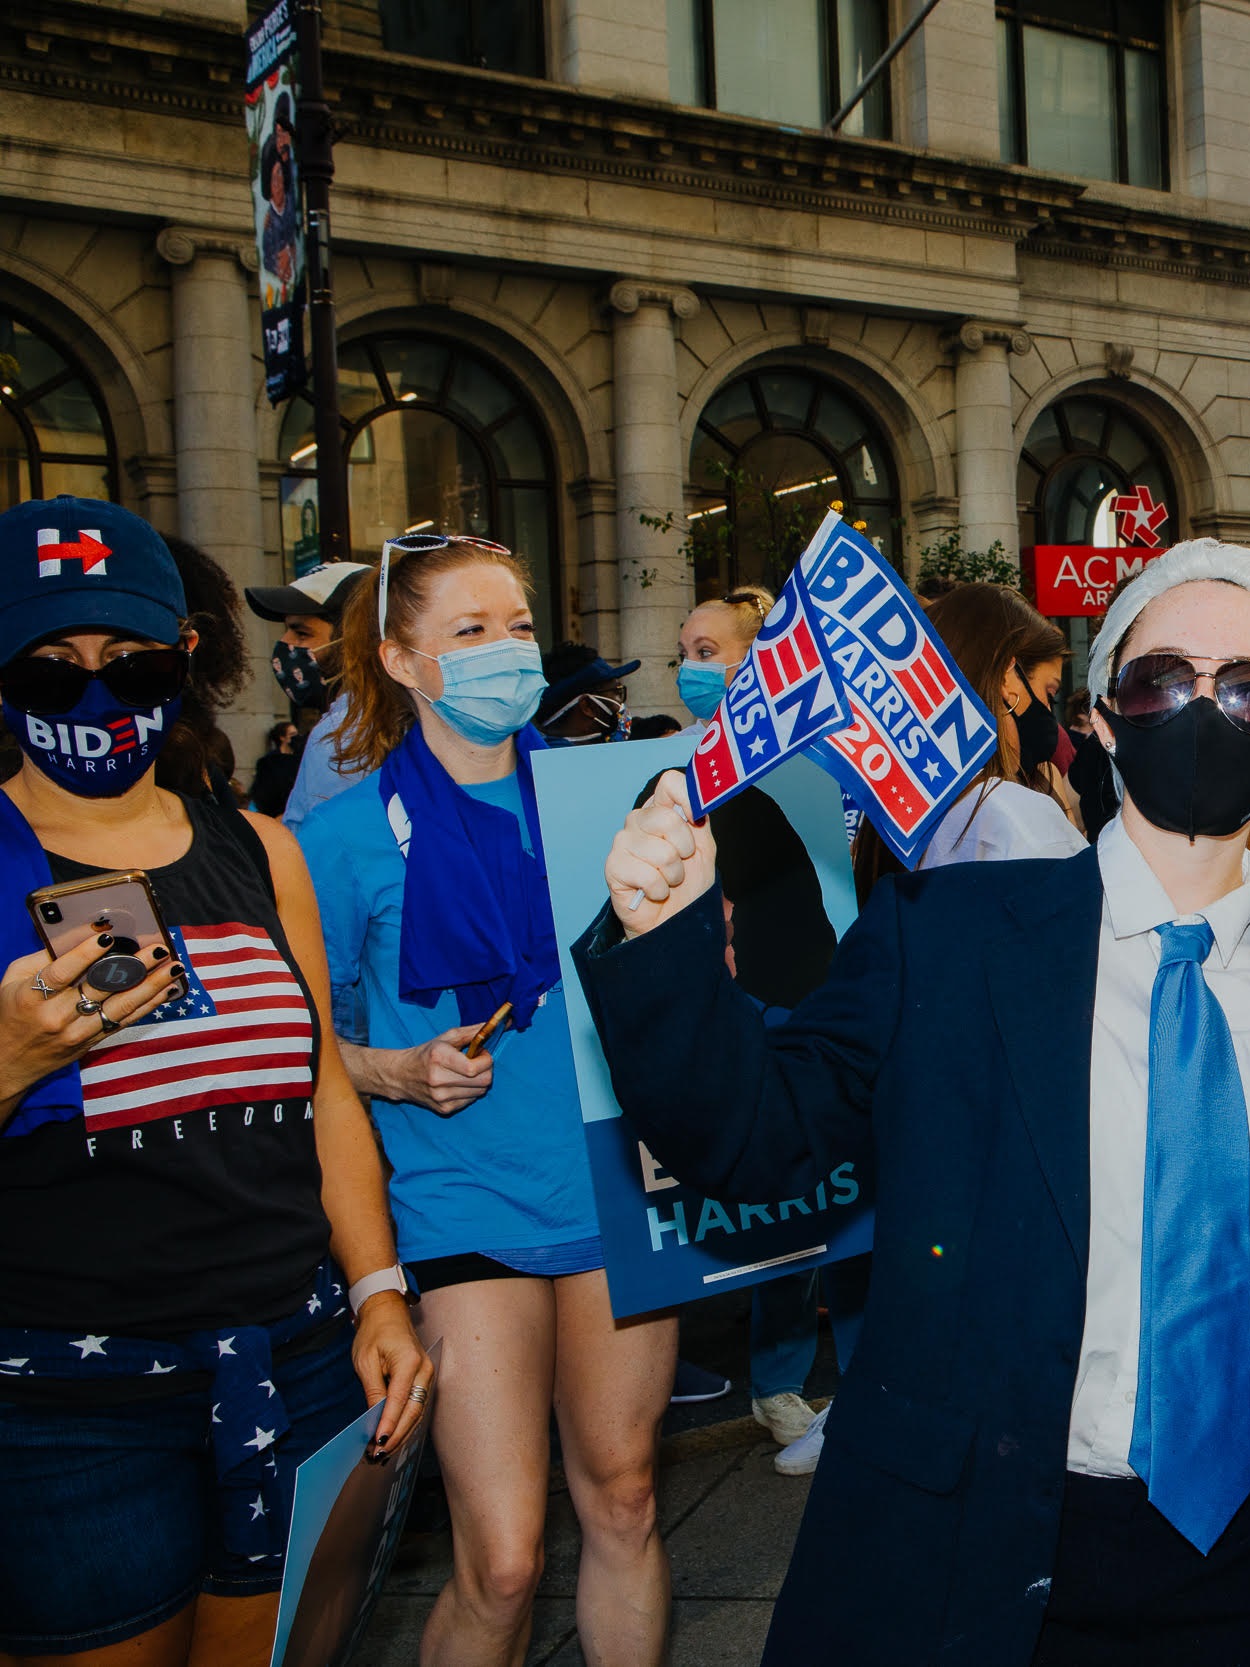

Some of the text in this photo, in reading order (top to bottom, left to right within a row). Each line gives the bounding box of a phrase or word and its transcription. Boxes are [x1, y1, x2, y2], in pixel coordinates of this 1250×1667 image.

[37, 528, 112, 577] H
[756, 573, 836, 749] DEN
[808, 541, 992, 769] BIDEN
[26, 706, 163, 758] BIDEN
[48, 744, 149, 772] HARRIS
[832, 701, 892, 782] 20
[86, 1102, 314, 1158] FREEDOM
